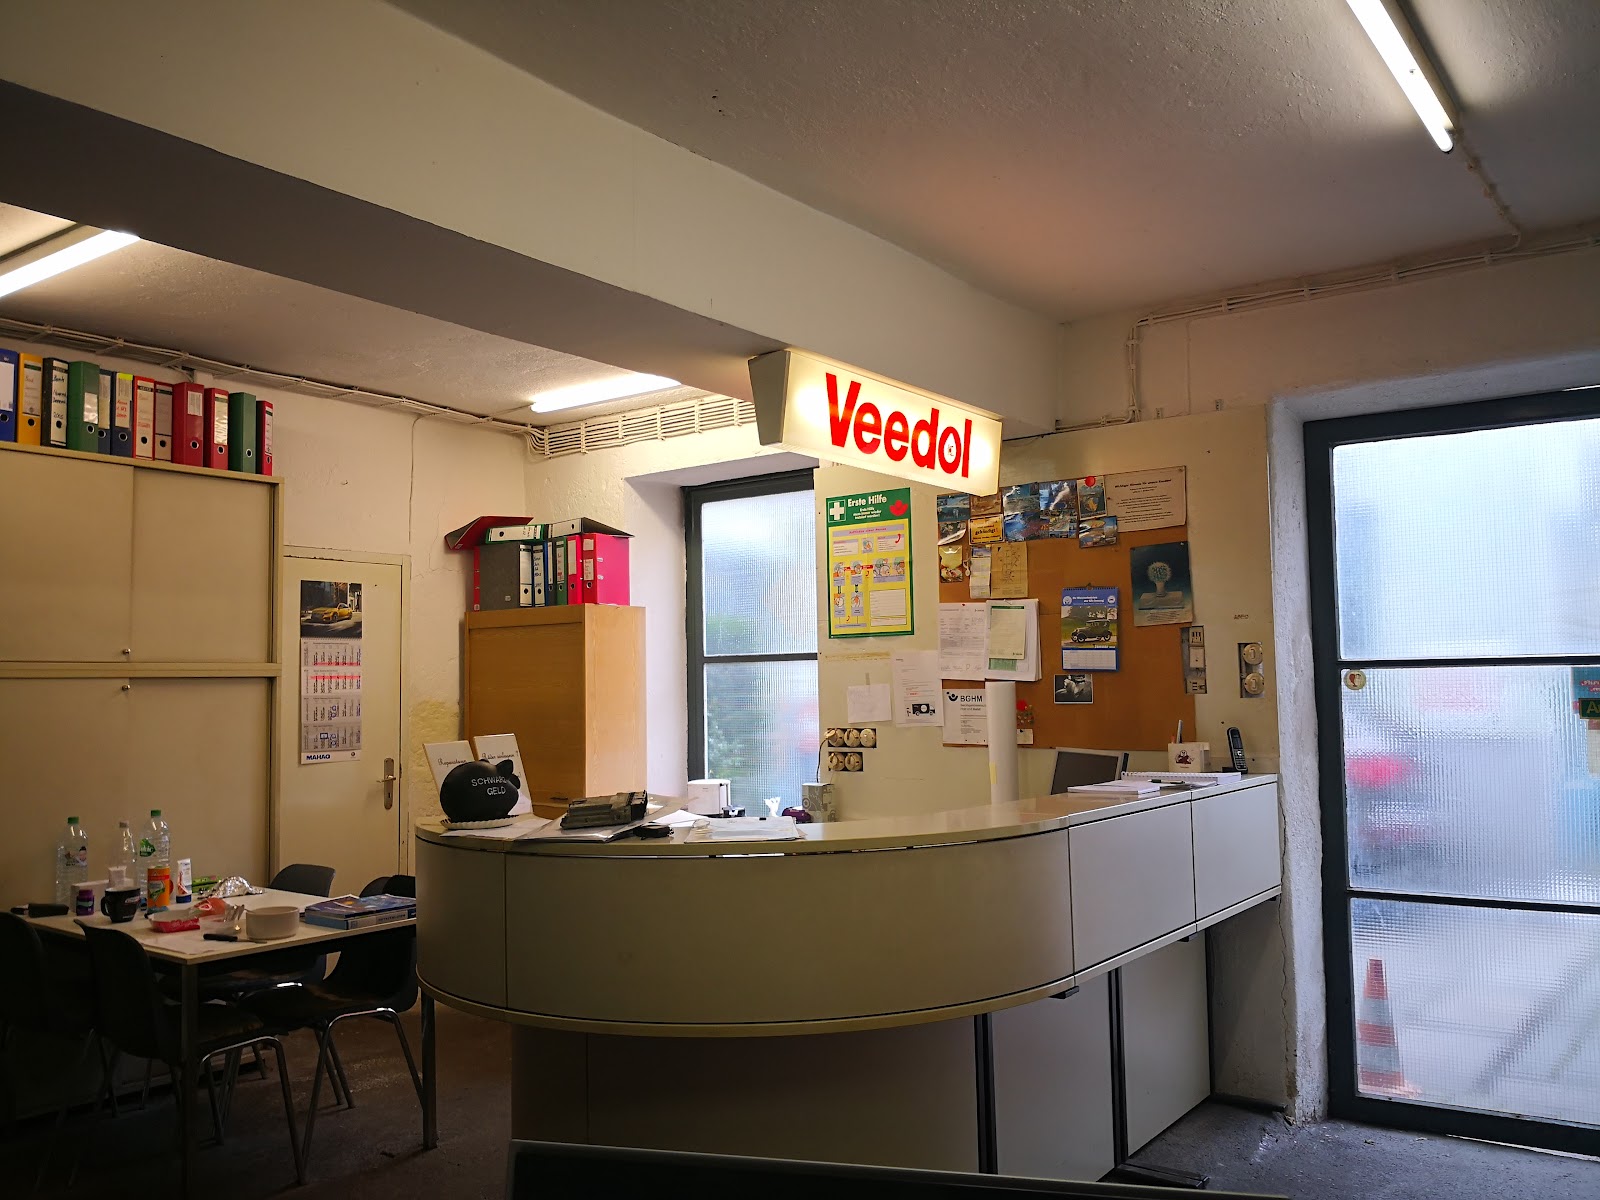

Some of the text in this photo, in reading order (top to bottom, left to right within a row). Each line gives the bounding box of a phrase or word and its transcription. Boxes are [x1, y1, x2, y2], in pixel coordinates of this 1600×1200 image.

[825, 372, 972, 478] Veedol
[847, 494, 887, 507] Erste Hilfe
[486, 786, 507, 796] GELD
